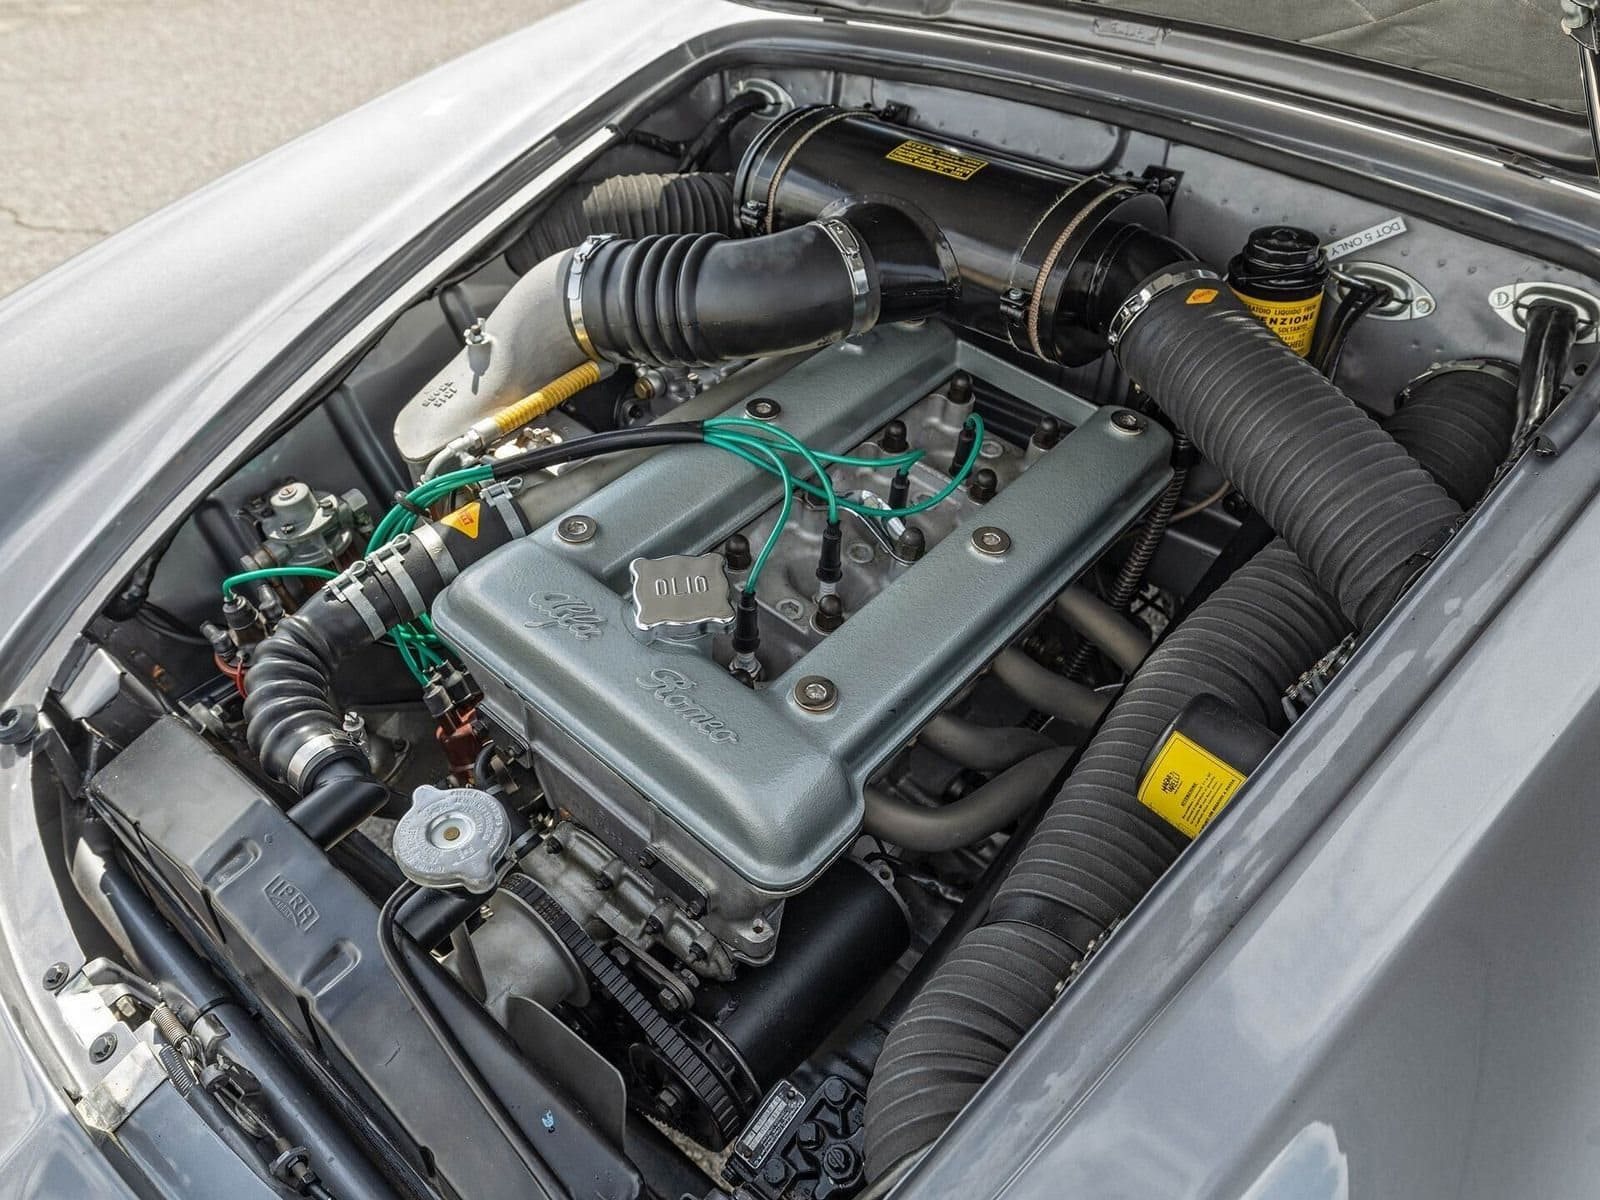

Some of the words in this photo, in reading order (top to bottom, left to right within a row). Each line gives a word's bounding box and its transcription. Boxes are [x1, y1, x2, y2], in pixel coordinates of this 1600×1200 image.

[1364, 232, 1373, 242] 5
[1376, 222, 1401, 239] DOT
[1331, 237, 1363, 257] ONLY
[655, 574, 709, 597] OLIO
[523, 590, 609, 642] Alfa
[635, 667, 741, 745] Romeo
